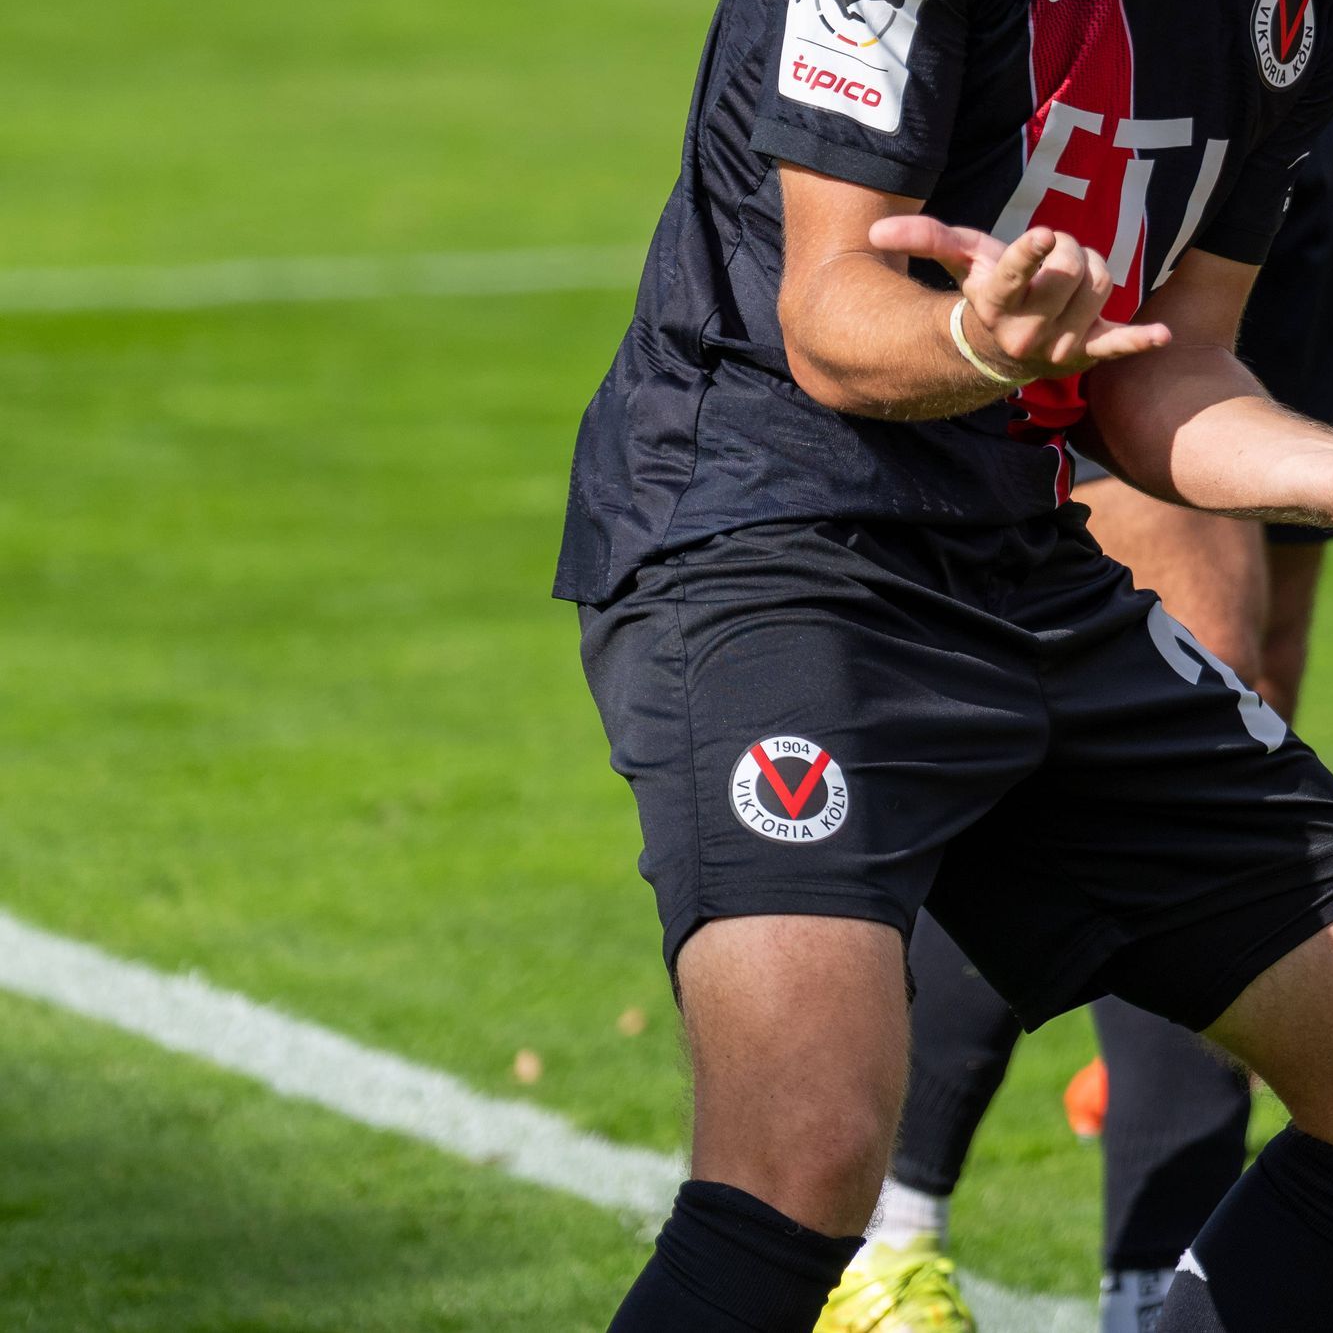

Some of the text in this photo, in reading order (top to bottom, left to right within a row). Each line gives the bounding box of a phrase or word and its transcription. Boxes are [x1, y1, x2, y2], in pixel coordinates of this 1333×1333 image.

[1257, 6, 1314, 85] VIKTORIA KÖLN
[792, 54, 882, 108] tipico
[773, 740, 811, 755] 1904
[737, 778, 846, 839] VIKTORIA KÖLN
